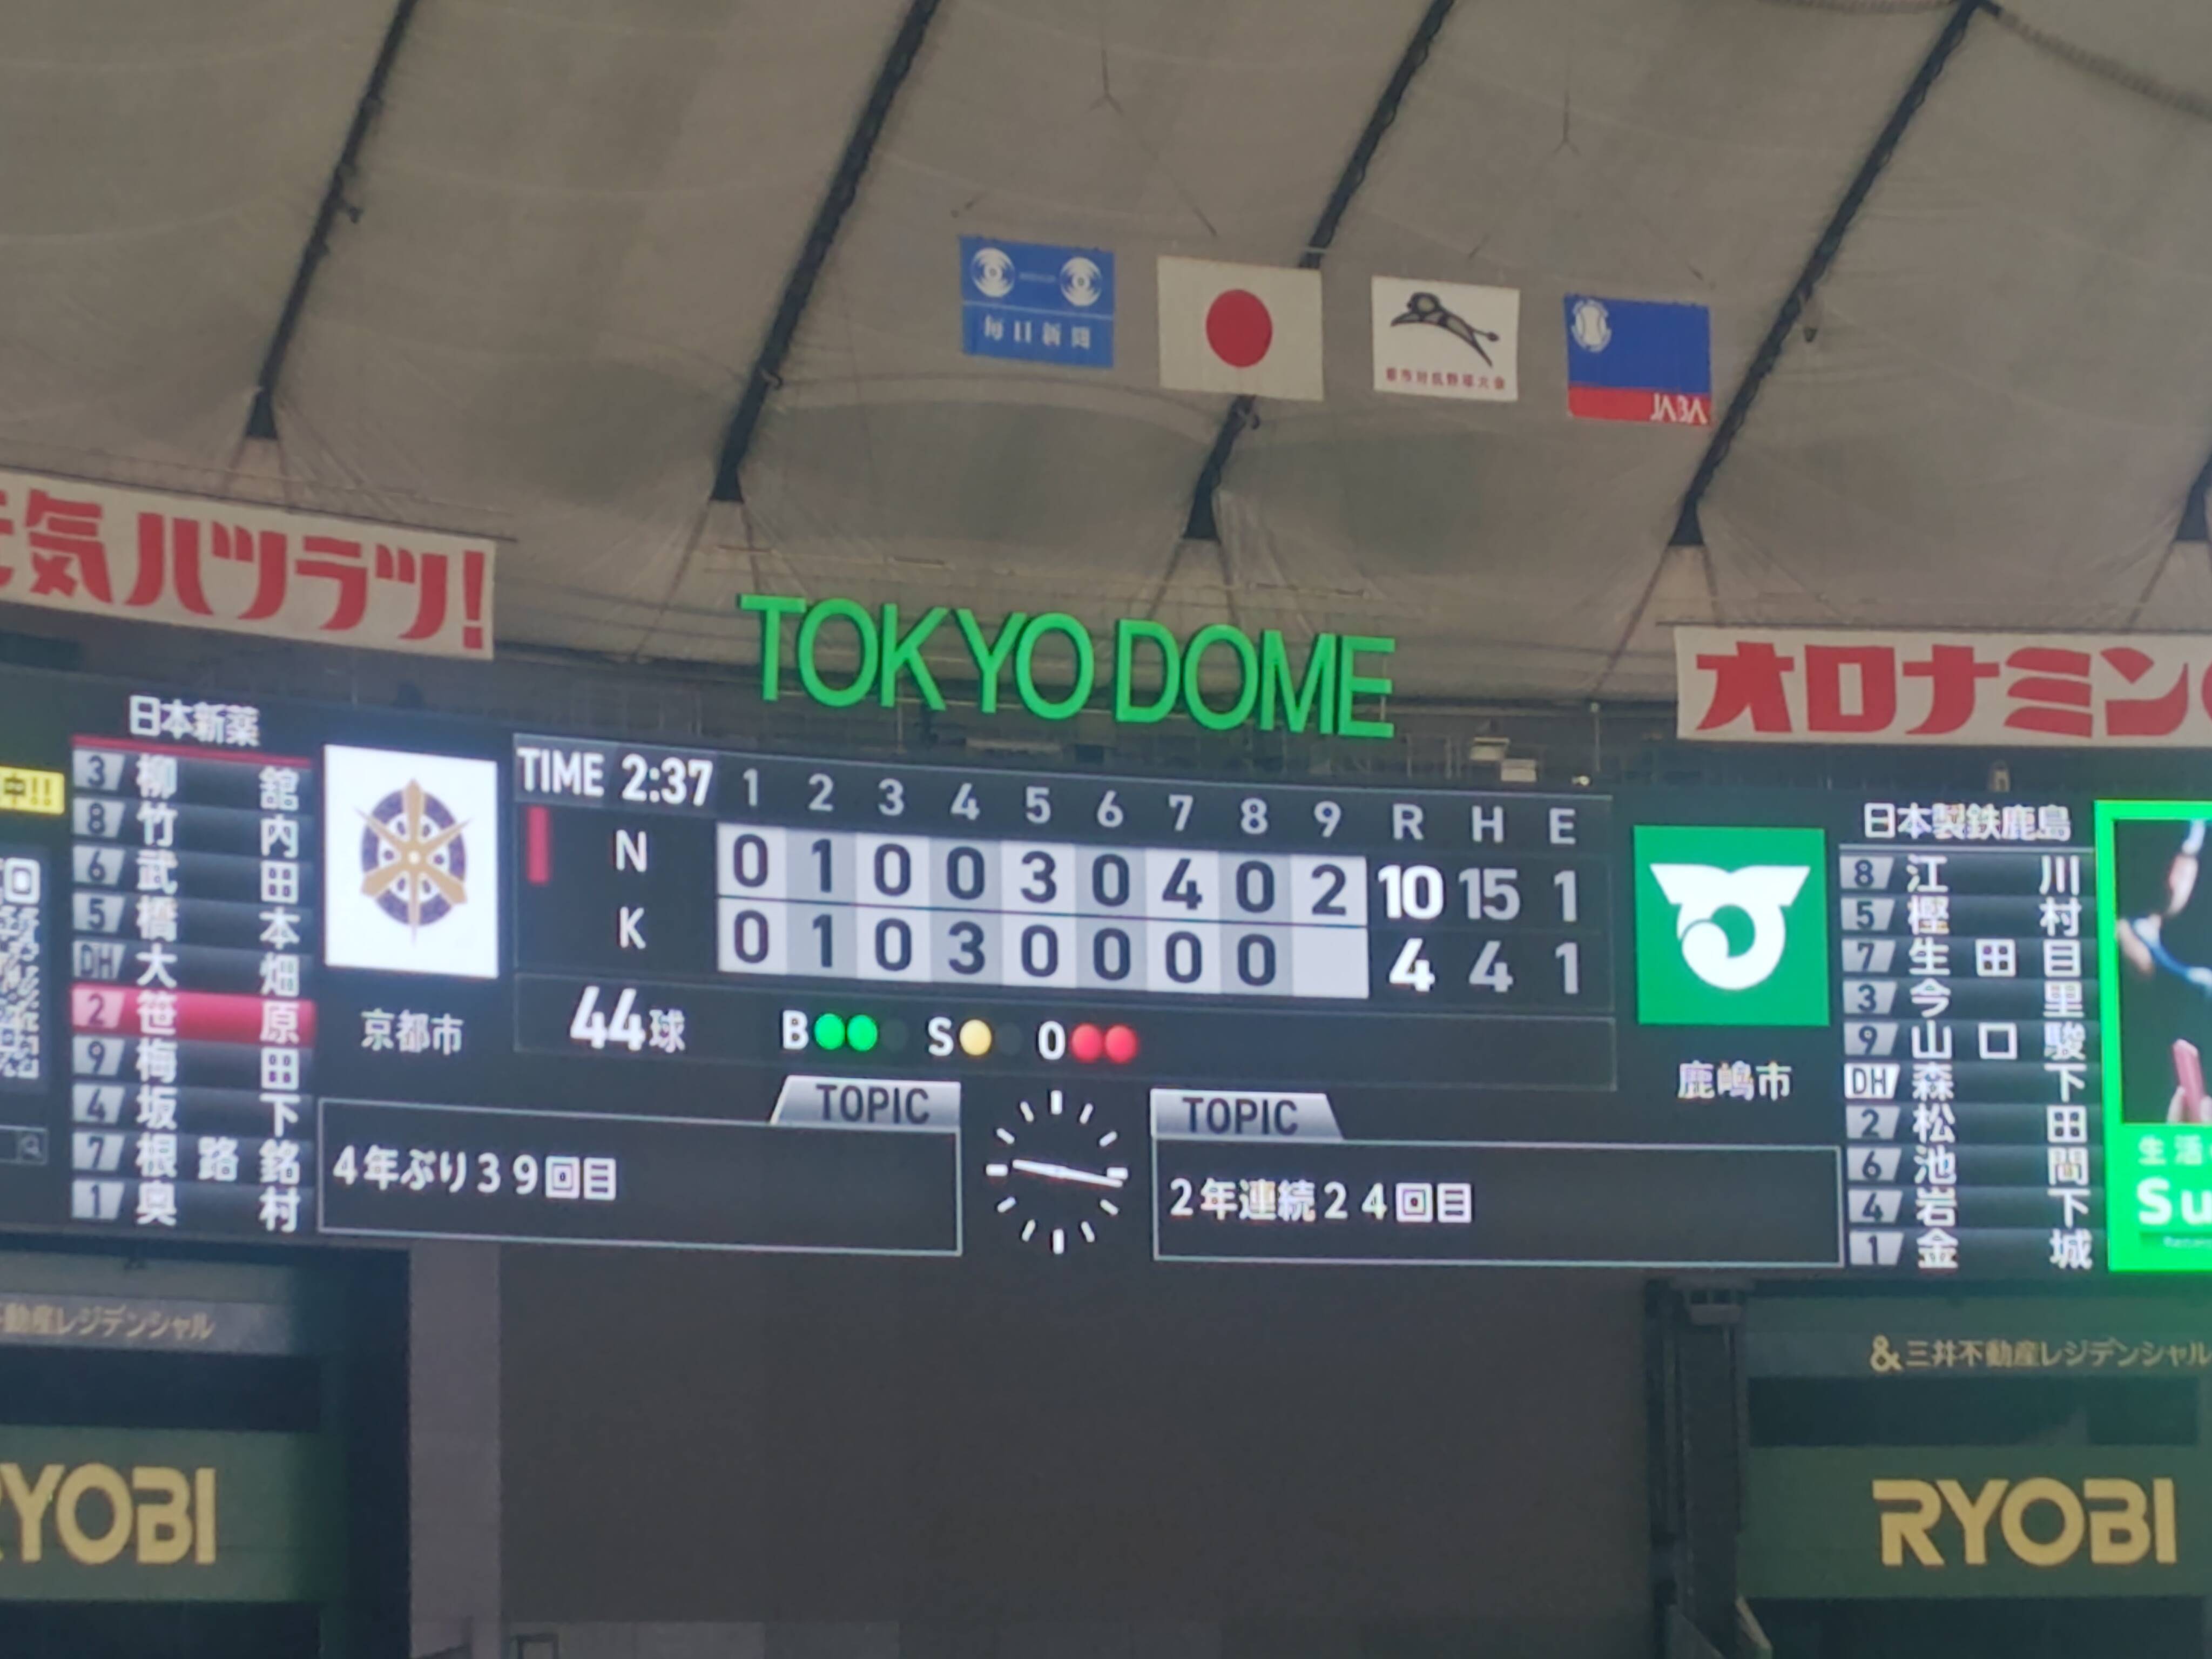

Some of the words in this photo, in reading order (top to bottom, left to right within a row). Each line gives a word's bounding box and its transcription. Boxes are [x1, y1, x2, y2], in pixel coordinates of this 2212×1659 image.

[1650, 392, 1708, 425] JABA
[0, 488, 485, 649] 気ハツラツ!
[736, 593, 1094, 720] TOKYO
[1115, 618, 1395, 738] DOME
[1696, 640, 2212, 738] オロナミン
[130, 694, 260, 746] 日本新薬
[89, 756, 105, 787] 3
[517, 747, 604, 797] TIME
[621, 753, 712, 806] 2:37
[88, 803, 105, 834] 8
[743, 768, 757, 806] 1
[808, 773, 834, 811] 2
[878, 778, 904, 816] 3
[950, 783, 980, 820] 4
[1026, 786, 1050, 824] 5
[1097, 790, 1123, 827] 6
[1169, 794, 1193, 832] 7
[1241, 798, 1267, 835] 8
[1314, 801, 1341, 838] 9
[1392, 804, 1424, 840] R
[1472, 806, 1504, 843] H
[1549, 808, 1576, 845] E
[1864, 802, 2071, 841] 日本製鉄鹿島
[88, 851, 105, 882] 6
[616, 829, 647, 872] N
[733, 833, 768, 887] 0
[812, 838, 833, 893] 1
[874, 843, 911, 896] 0
[947, 846, 985, 900] 0
[1021, 851, 1057, 903] 3
[1092, 854, 1130, 907] 0
[1162, 858, 1202, 910] 4
[1236, 860, 1275, 913] 0
[1311, 864, 1346, 915] 2
[1378, 865, 1444, 920] 10
[1458, 867, 1521, 920] 15
[1553, 870, 1576, 922] 1
[1853, 859, 1872, 885] 8
[89, 899, 105, 930] 5
[1856, 902, 1874, 926] 5
[80, 944, 113, 978] DH
[619, 906, 646, 949] K
[734, 910, 768, 964] 0
[812, 914, 833, 968] 1
[875, 918, 912, 971] 0
[948, 921, 985, 975] 3
[1021, 925, 1058, 977] 0
[1094, 928, 1131, 981] 0
[1164, 930, 1202, 983] 0
[1237, 934, 1276, 987] 0
[1388, 938, 1435, 992] 4
[1469, 940, 1513, 993] 4
[1555, 942, 1578, 994] 1
[1857, 942, 1874, 970] 7
[88, 994, 105, 1026] 2
[1857, 983, 1876, 1010] 3
[360, 1008, 463, 1055] 京都市
[782, 1010, 809, 1050] B
[928, 1017, 954, 1057] S
[1859, 1026, 1878, 1055] 9
[88, 1041, 105, 1074] 9
[1678, 1059, 1792, 1101] 鹿嶋市
[1852, 1068, 1887, 1095] DH
[87, 1089, 105, 1121] 4
[815, 1083, 930, 1125] TOPIC
[1182, 1097, 1298, 1135] TOPIC
[1861, 1109, 1879, 1138] 2
[88, 1136, 105, 1168] 7
[1862, 1151, 1882, 1179] 6
[2138, 1135, 2212, 1165] 生活
[91, 1184, 101, 1218] 1
[1862, 1192, 1883, 1222] 4
[1868, 1235, 1878, 1264] 1
[0, 1303, 215, 1340] 動産レジデンシャル
[0, 1462, 216, 1563] YOBI
[1872, 1476, 2177, 1566] RYOBI
